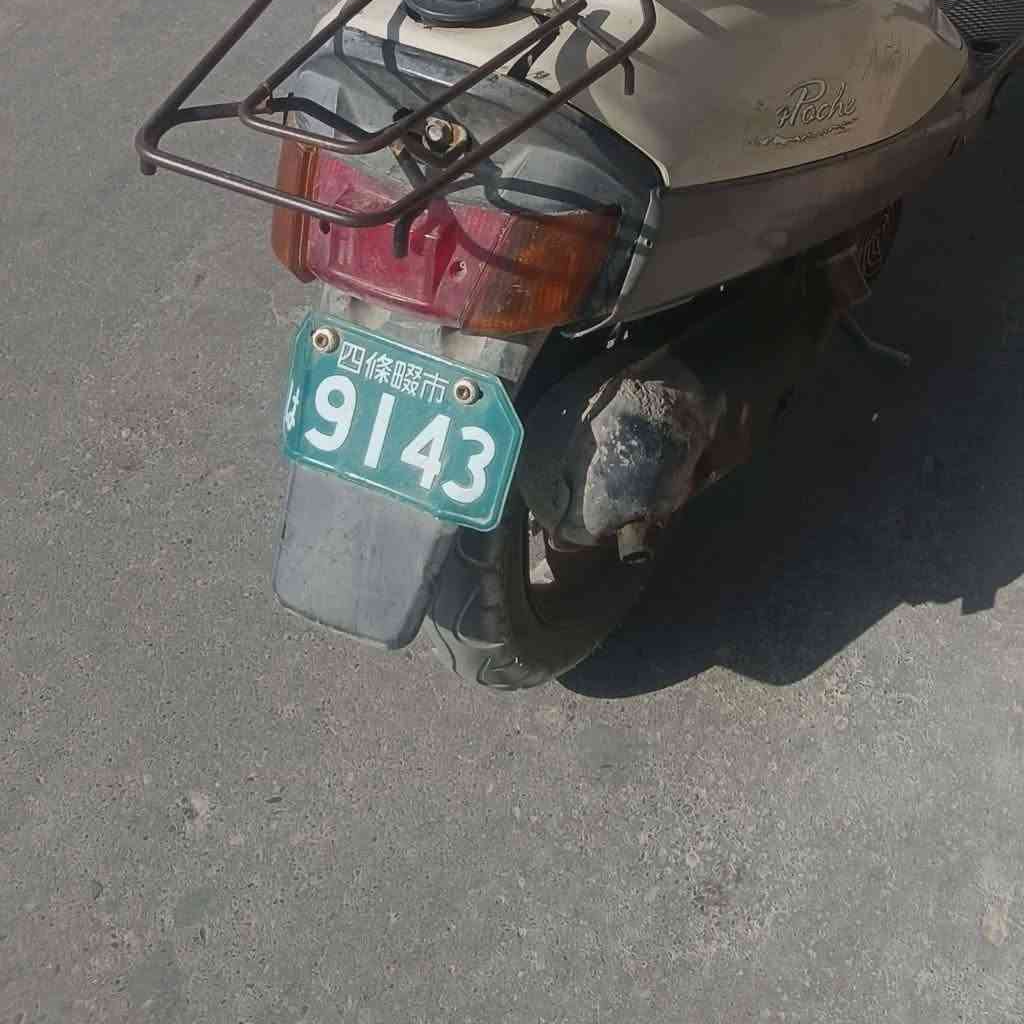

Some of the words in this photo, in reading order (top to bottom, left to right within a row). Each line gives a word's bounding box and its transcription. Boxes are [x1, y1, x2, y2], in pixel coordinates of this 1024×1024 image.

[337, 341, 450, 404] 四條畷市
[304, 375, 496, 504] 9143
